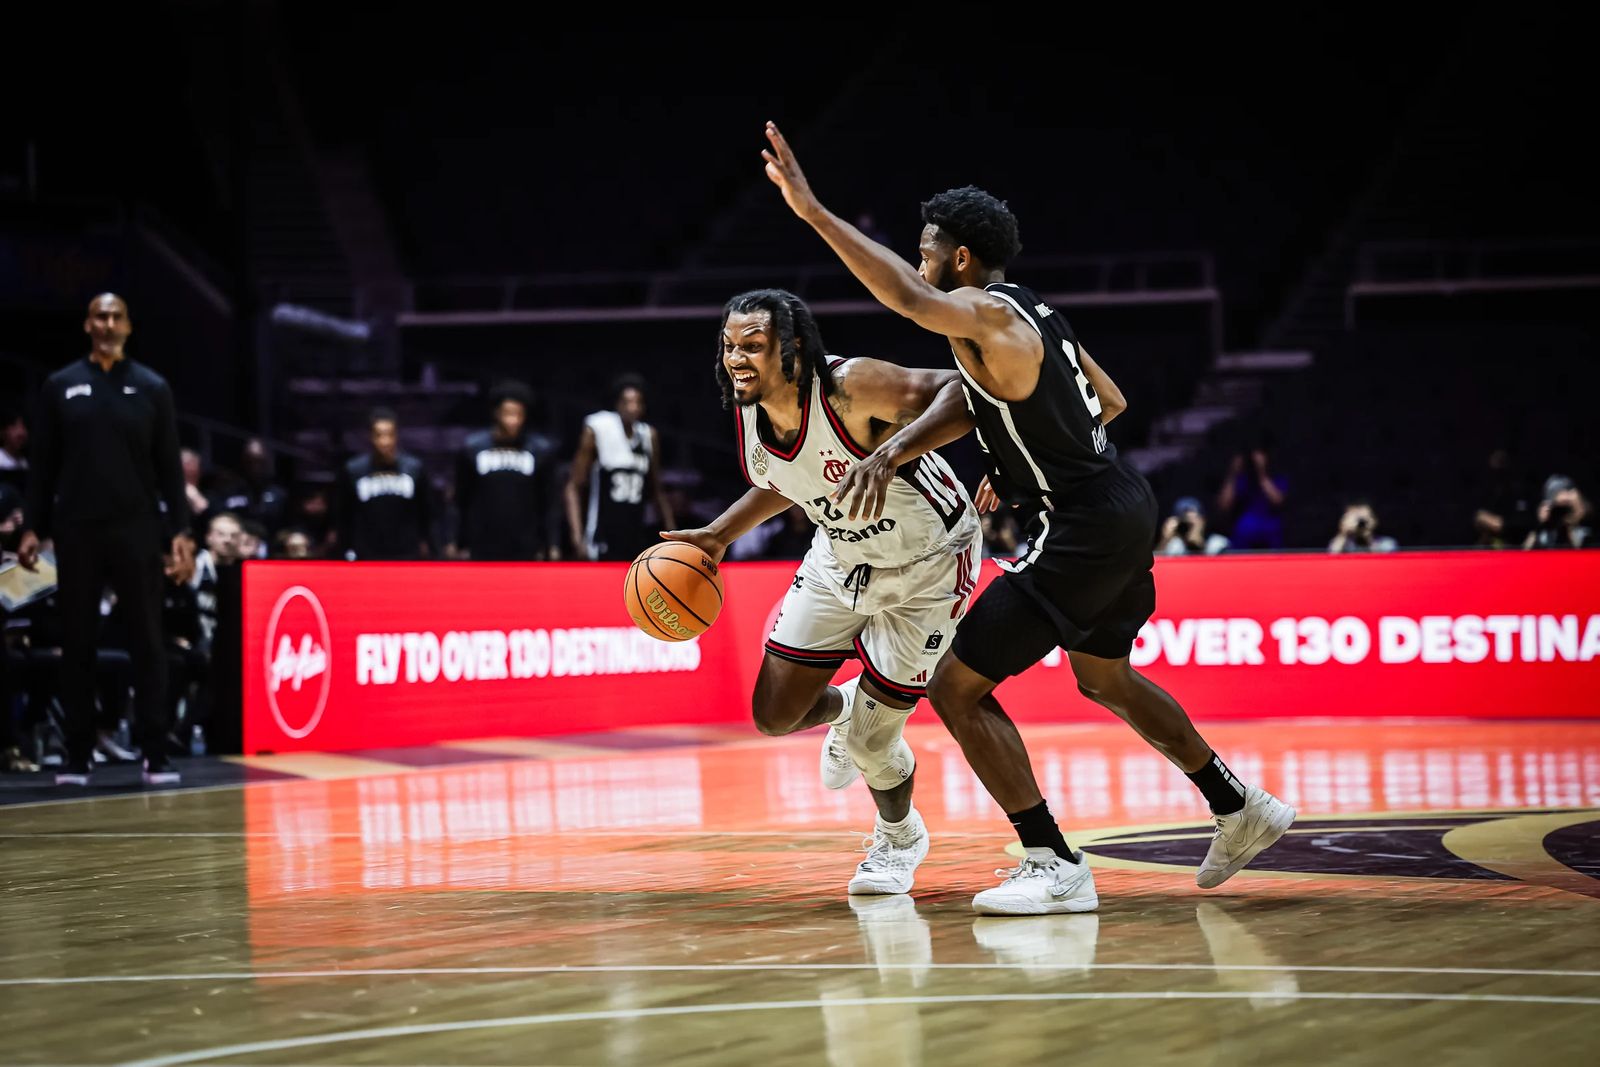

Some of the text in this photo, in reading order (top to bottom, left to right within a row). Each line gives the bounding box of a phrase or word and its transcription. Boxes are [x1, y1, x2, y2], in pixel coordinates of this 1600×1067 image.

[817, 518, 896, 543] etano
[356, 633, 401, 685] FLY
[401, 631, 440, 683] TO
[442, 630, 508, 682] OVER
[508, 628, 551, 679] 130
[1270, 616, 1371, 665] 130
